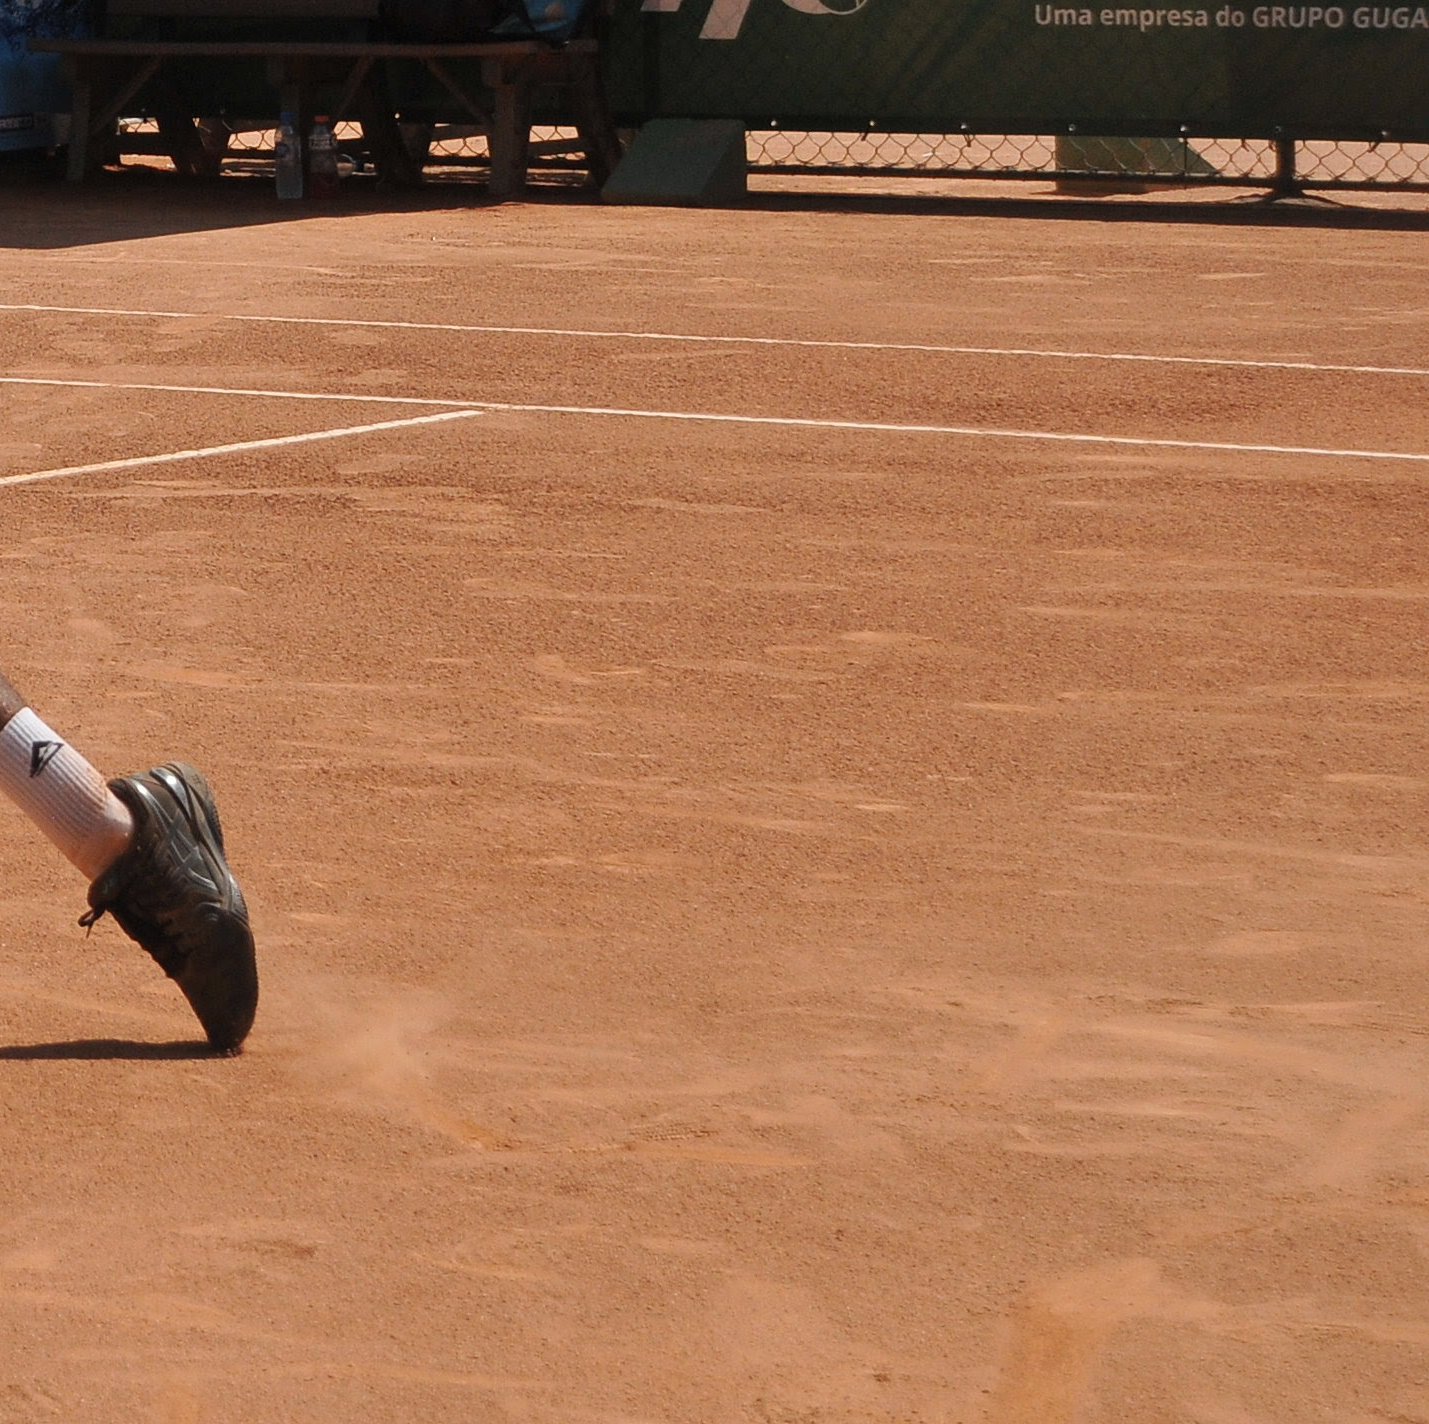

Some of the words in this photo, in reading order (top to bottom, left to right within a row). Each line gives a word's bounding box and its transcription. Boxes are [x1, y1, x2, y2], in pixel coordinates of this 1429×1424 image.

[1035, 4, 1093, 26] Uma
[1100, 9, 1208, 32] empresa
[1216, 5, 1244, 27] do
[1253, 6, 1344, 28] GRUPO
[1353, 6, 1429, 29] GUGA
